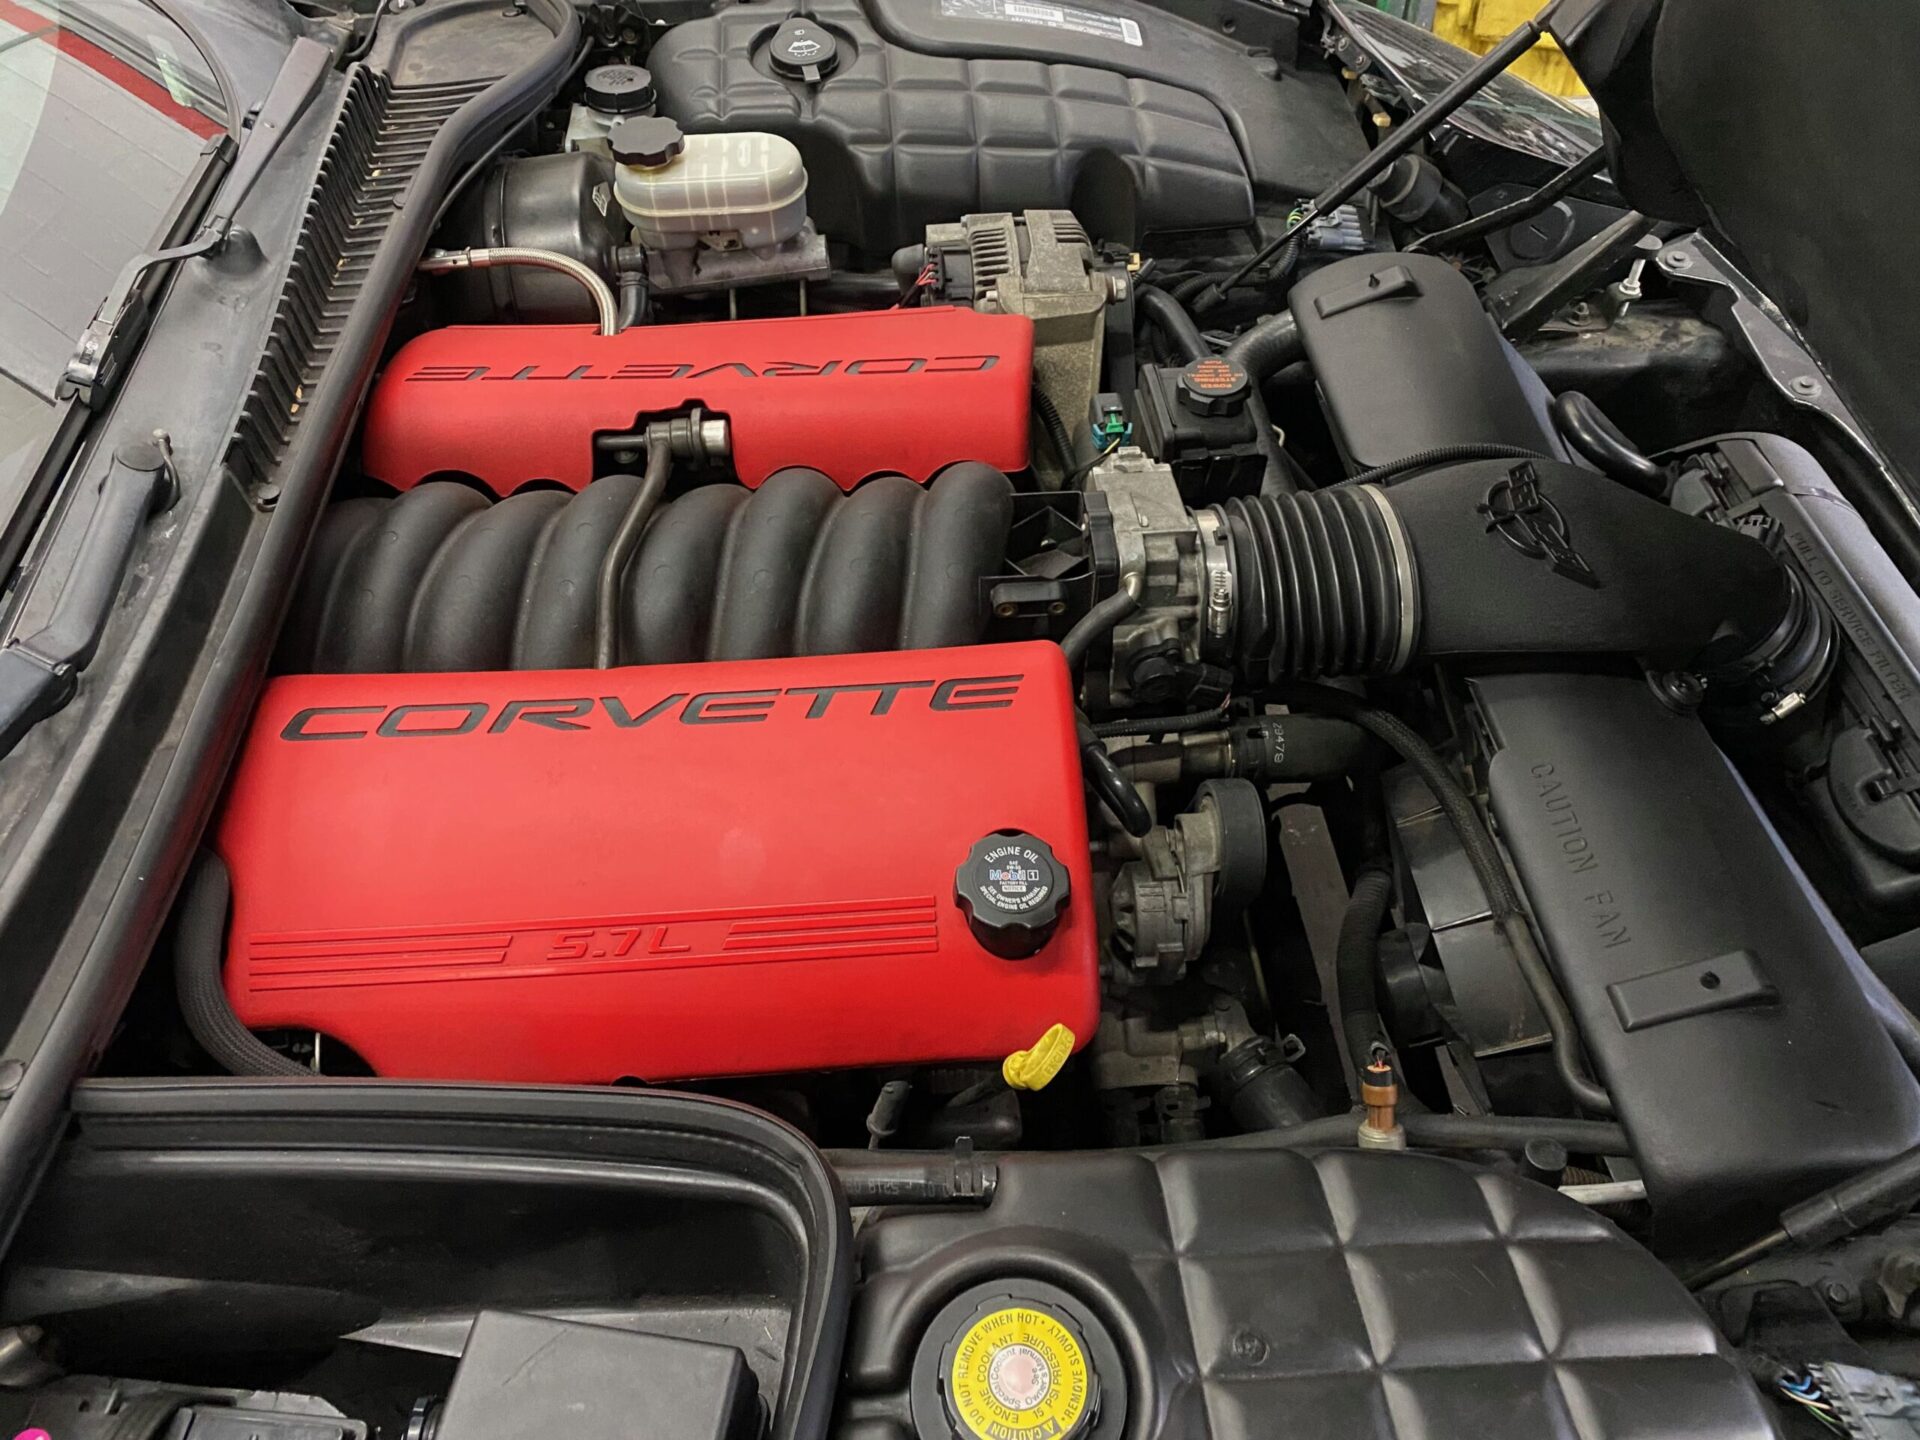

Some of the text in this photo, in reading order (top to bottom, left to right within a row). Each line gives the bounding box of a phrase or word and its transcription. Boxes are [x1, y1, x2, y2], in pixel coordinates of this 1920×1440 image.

[404, 355, 1000, 382] CORVETTE
[280, 673, 1025, 742] CORVETTE
[984, 846, 1040, 864] ENGINE OIL
[1531, 763, 1632, 949] CAUTION FAN
[989, 869, 1026, 881] Mobil
[979, 885, 1048, 910] SPECIAL ENGINE OIL REQUIRED
[987, 885, 998, 896] SEE
[1021, 886, 1041, 903] MANUAL
[546, 926, 692, 962] 5.7L
[982, 1313, 1013, 1334] WHEN
[958, 1332, 983, 1379] REMOVE
[1019, 1347, 1048, 1372] Manual
[977, 1333, 1019, 1424] ENGINE COOLANT
[990, 1348, 1021, 1409] Special Coolant
[1023, 1332, 1062, 1420] 15 PSI PRESSURE
[1031, 1367, 1040, 1385] See
[1047, 1325, 1083, 1420] REMOVE SLOWLY
[958, 1383, 974, 1408] NOT
[970, 1408, 985, 1427] DO
[991, 1421, 1042, 1440] CAUTION
